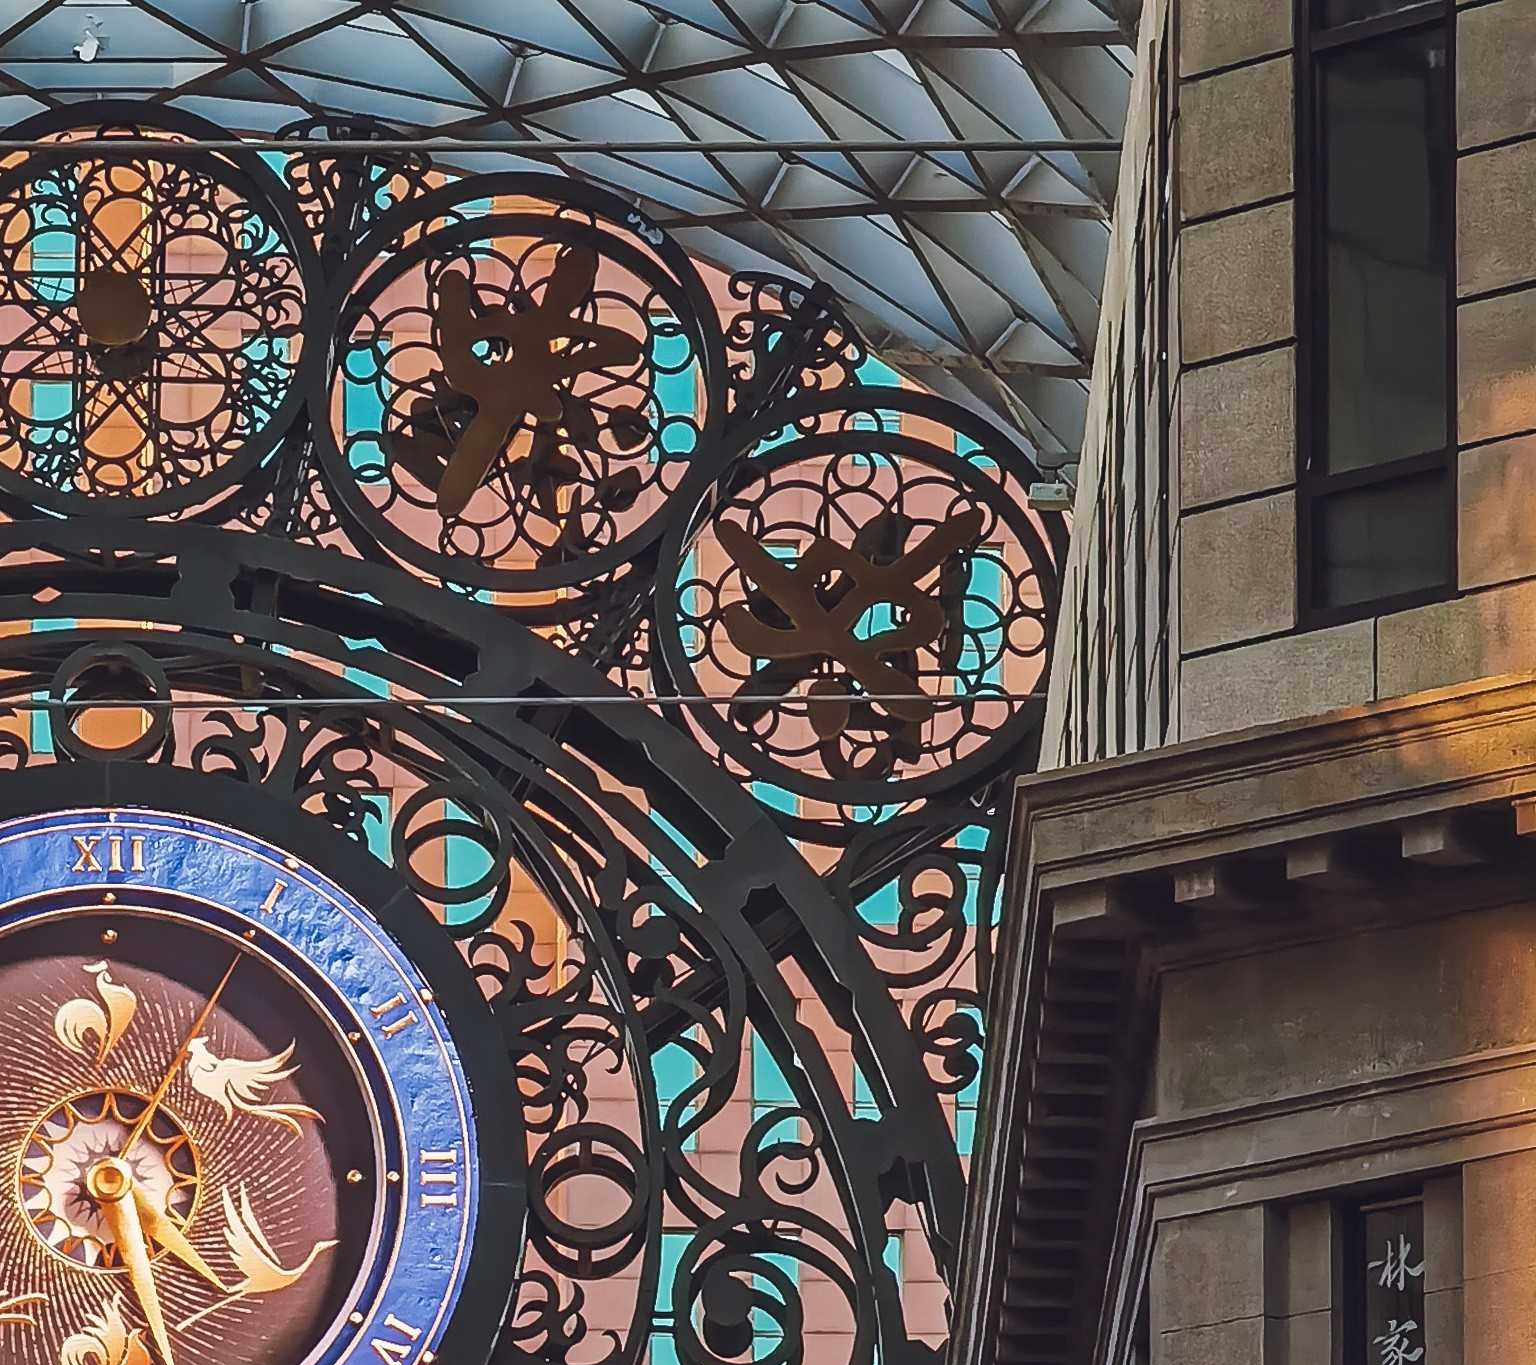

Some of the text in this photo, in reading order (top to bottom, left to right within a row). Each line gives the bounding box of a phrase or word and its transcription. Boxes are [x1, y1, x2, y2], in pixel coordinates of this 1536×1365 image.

[72, 836, 145, 872] XII
[259, 878, 284, 913] I
[371, 992, 419, 1037] II
[419, 1147, 456, 1206] III
